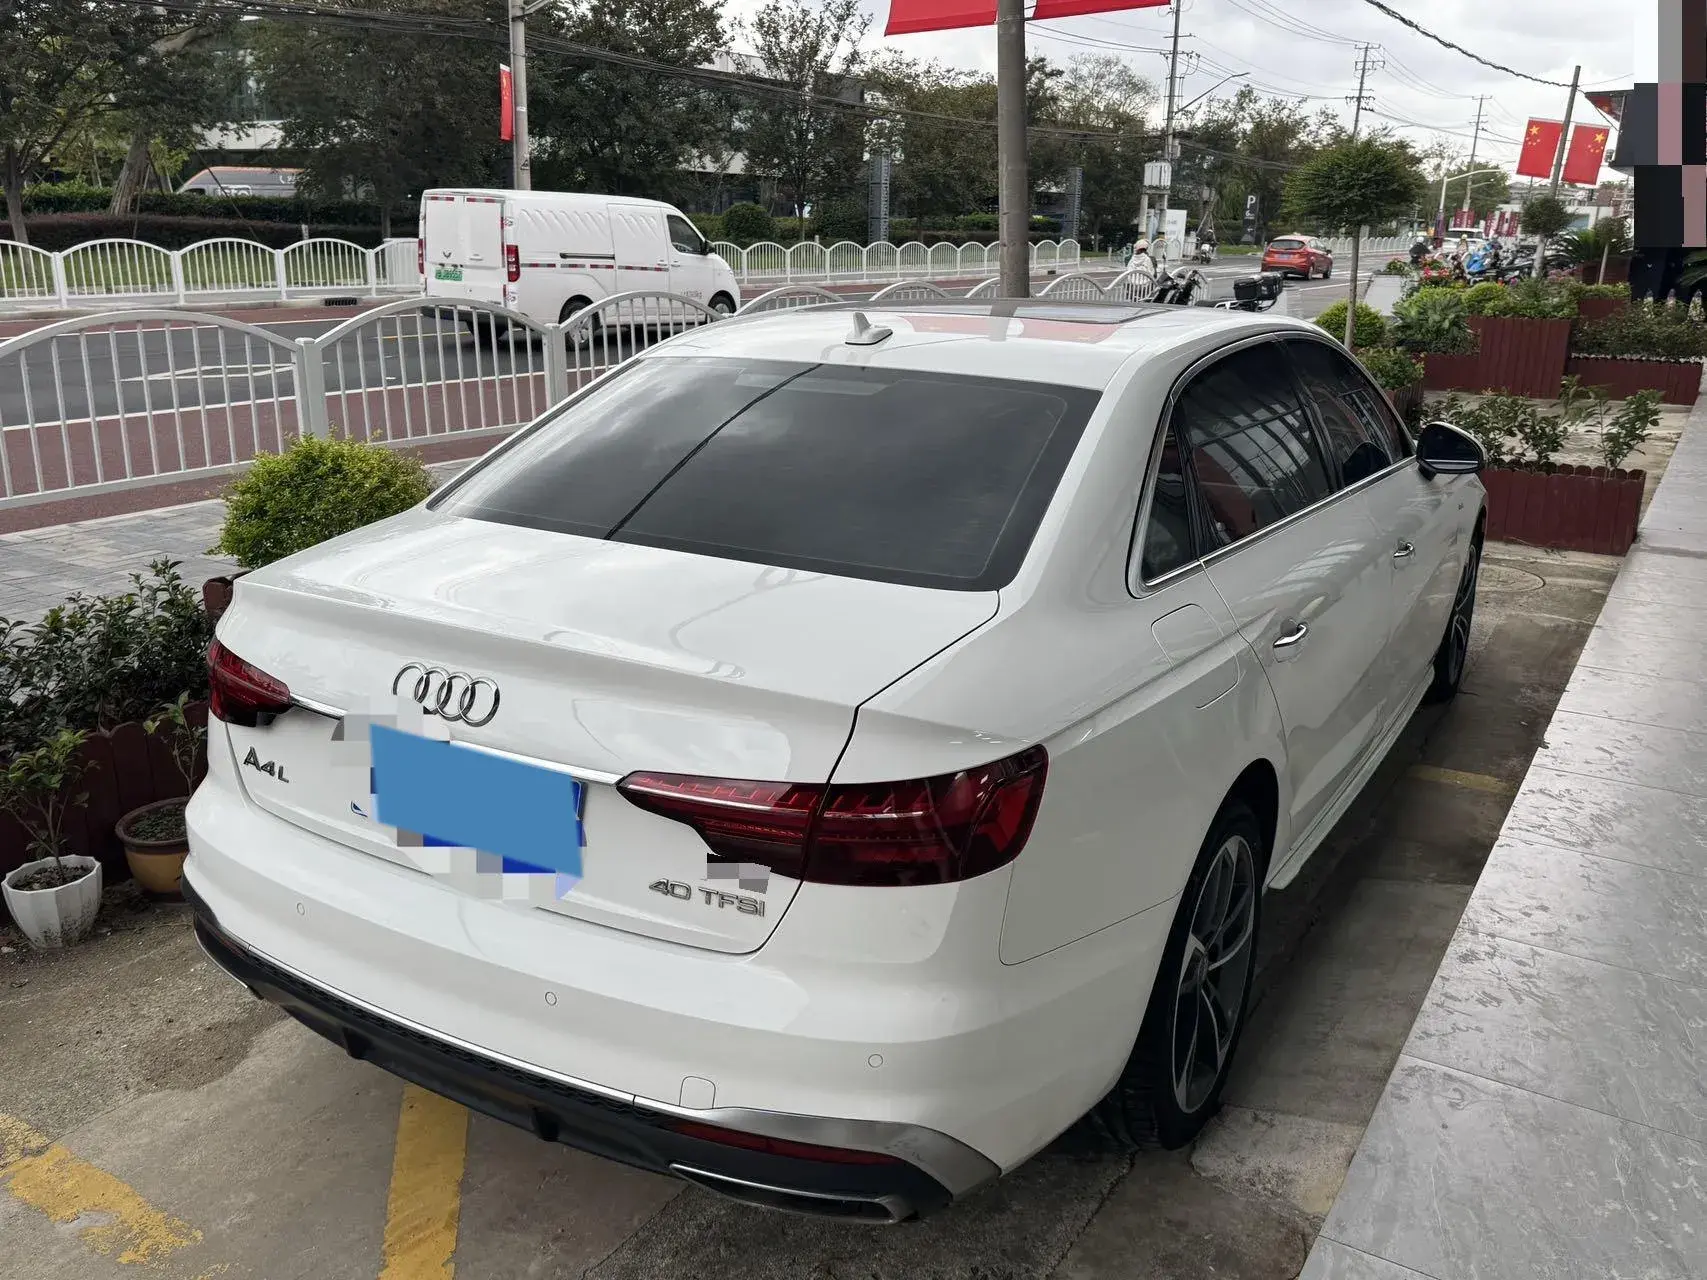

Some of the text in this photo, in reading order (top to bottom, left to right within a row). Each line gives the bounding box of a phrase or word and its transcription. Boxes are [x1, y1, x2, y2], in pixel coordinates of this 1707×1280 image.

[1247, 195, 1256, 209] P
[243, 746, 289, 783] A4L
[648, 878, 765, 917] 40 TFSI
